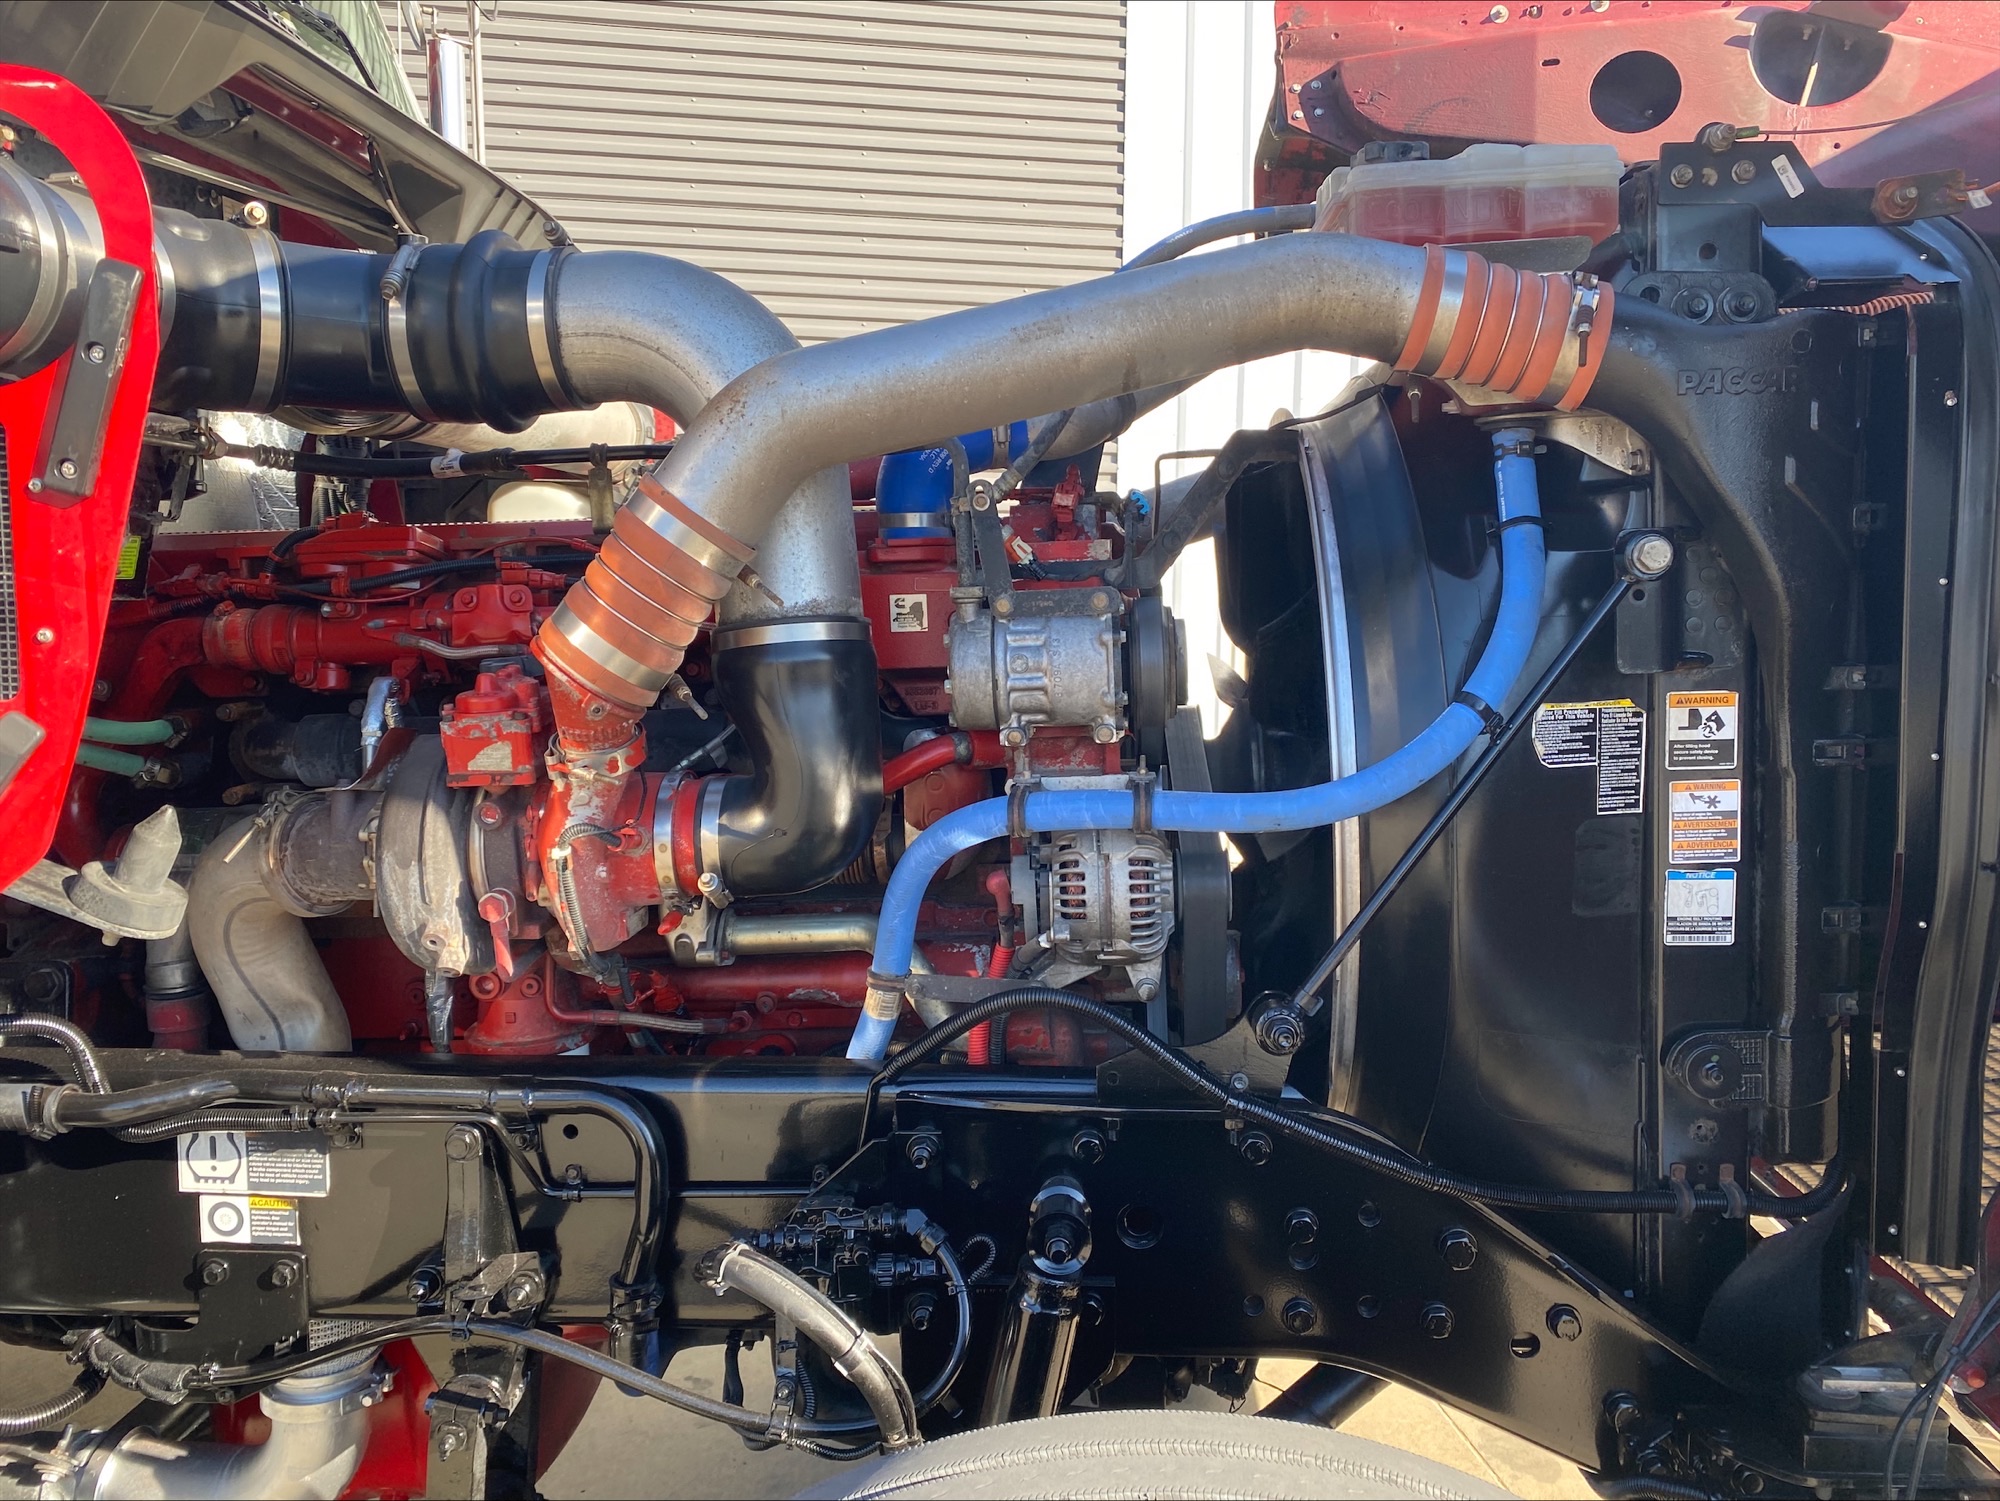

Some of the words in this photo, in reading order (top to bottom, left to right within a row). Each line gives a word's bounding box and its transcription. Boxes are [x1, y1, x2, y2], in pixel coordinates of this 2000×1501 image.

[1684, 696, 1729, 705] WARNING
[1683, 820, 1736, 828] AVERTISSEMENT
[1686, 840, 1734, 848] ADVERTENCIA
[1685, 871, 1717, 879] NOTICE
